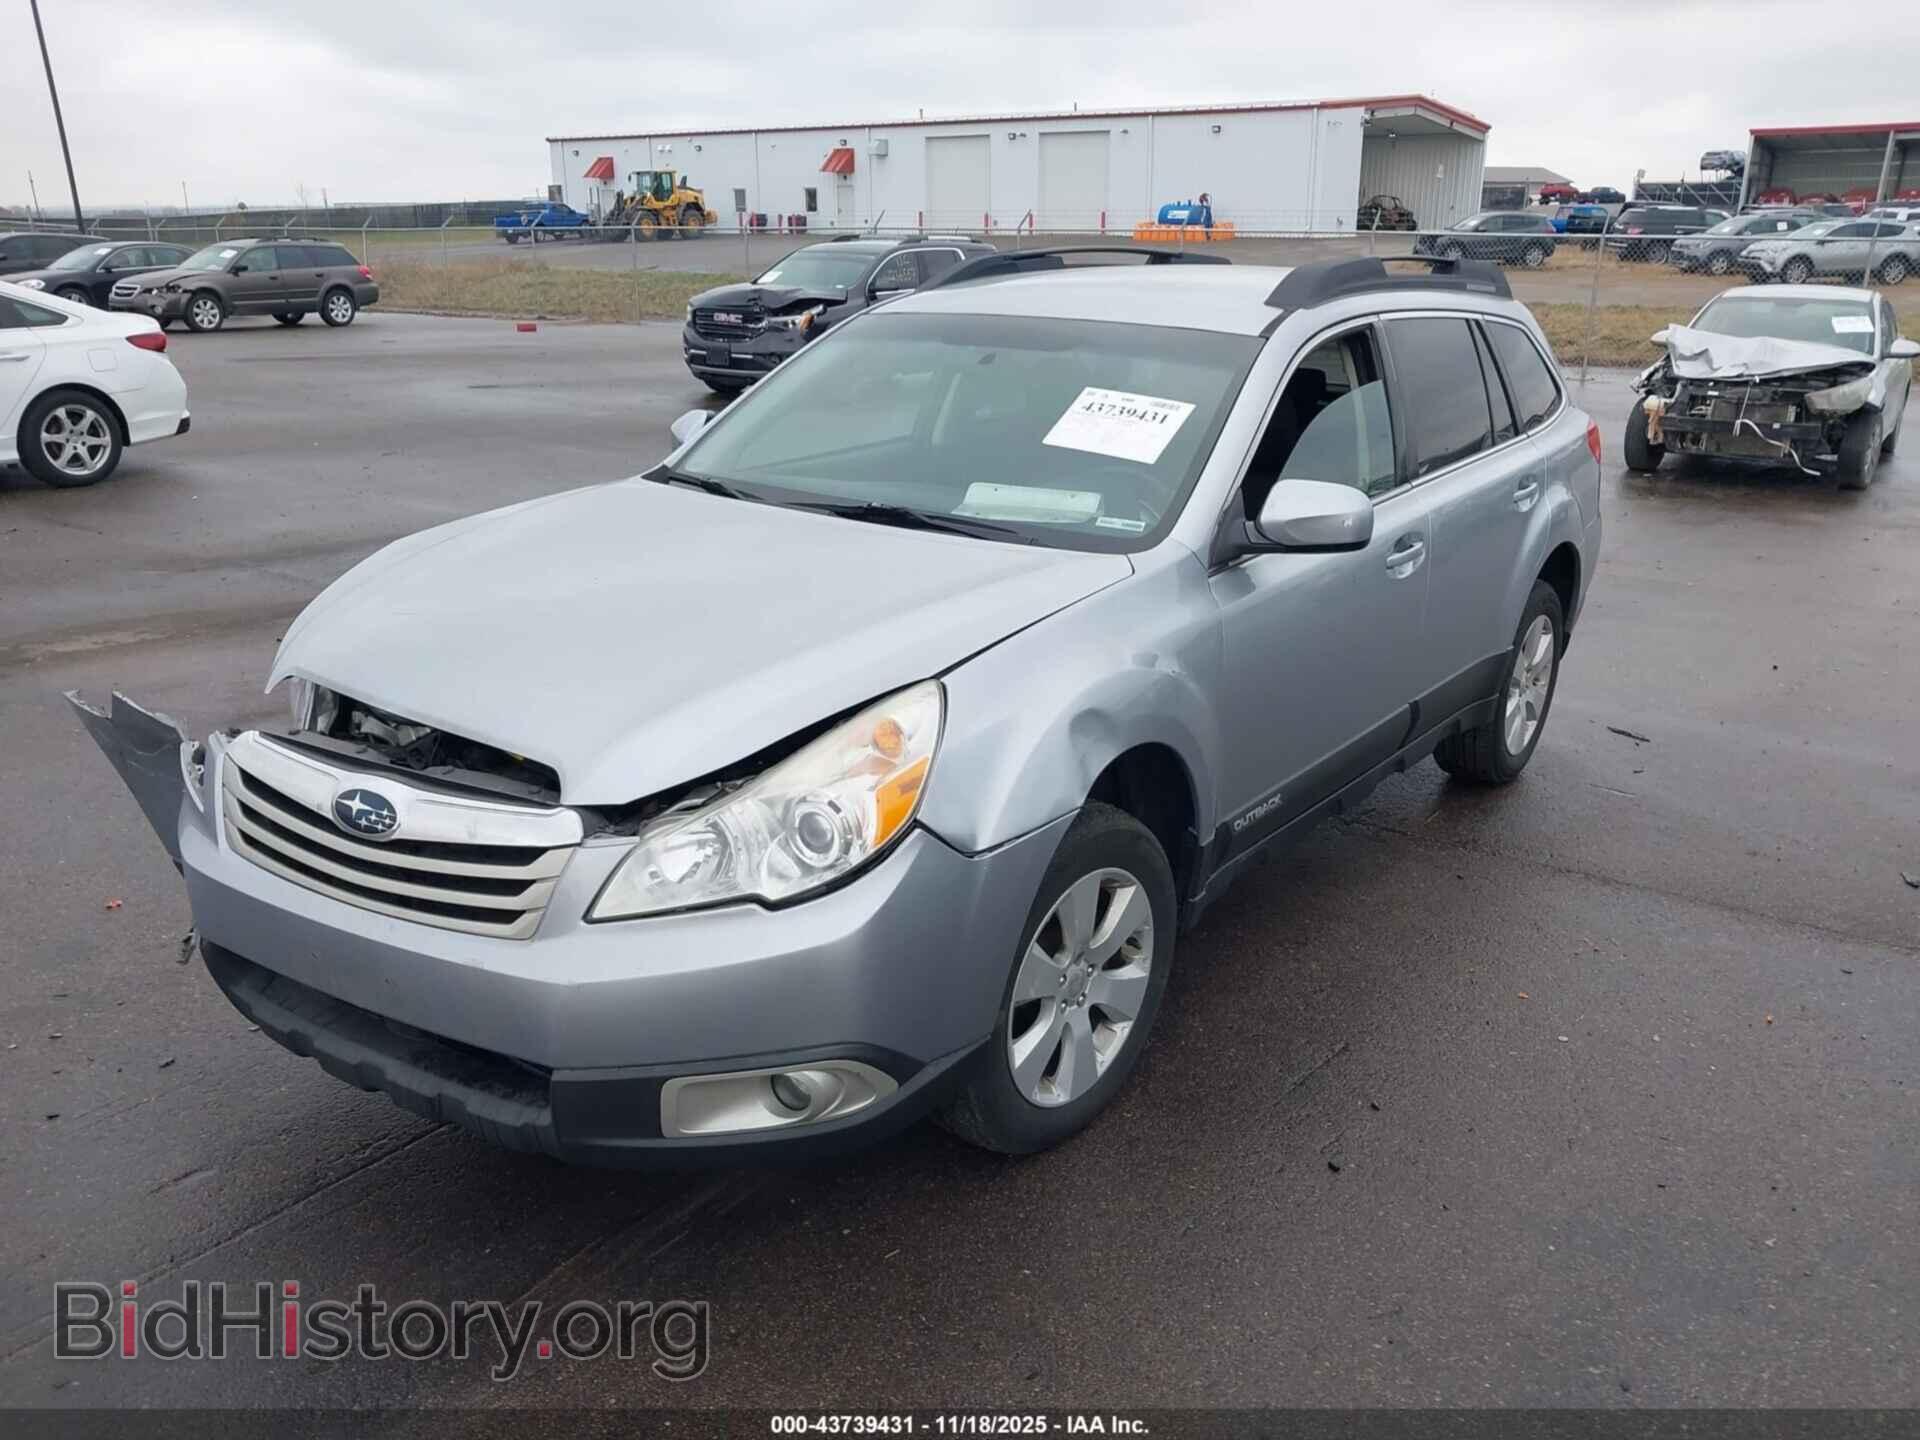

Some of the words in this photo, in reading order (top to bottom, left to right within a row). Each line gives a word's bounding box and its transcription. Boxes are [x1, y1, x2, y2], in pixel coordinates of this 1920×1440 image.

[713, 312, 743, 323] GMC
[1081, 400, 1169, 425] 43739431
[1233, 793, 1282, 832] OUTBACK
